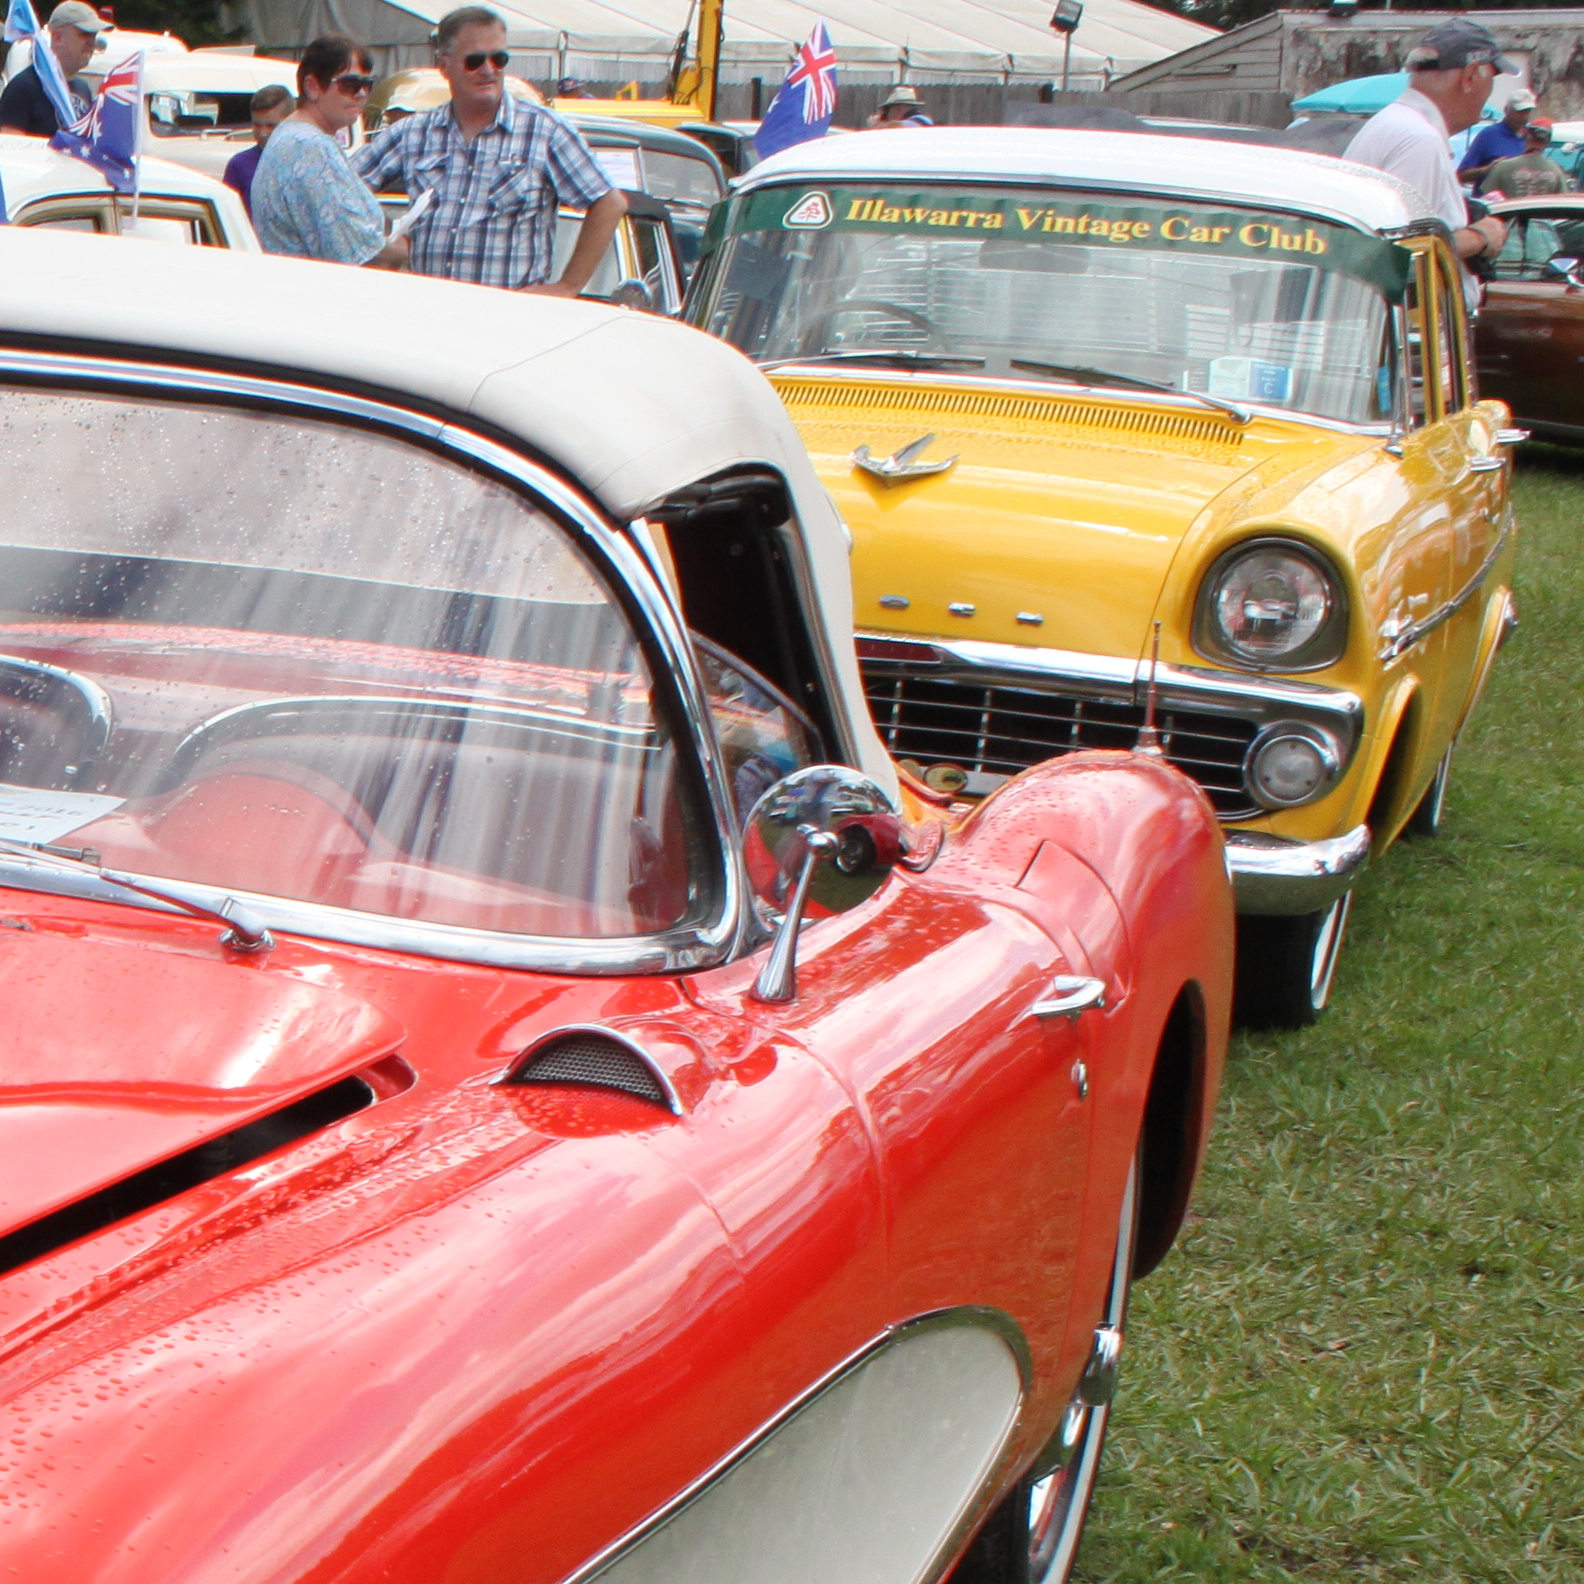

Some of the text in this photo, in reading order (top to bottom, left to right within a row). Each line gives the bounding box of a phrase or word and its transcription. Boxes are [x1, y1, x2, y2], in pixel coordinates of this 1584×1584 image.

[844, 198, 1326, 255] Illawarra Vintage Car Club
